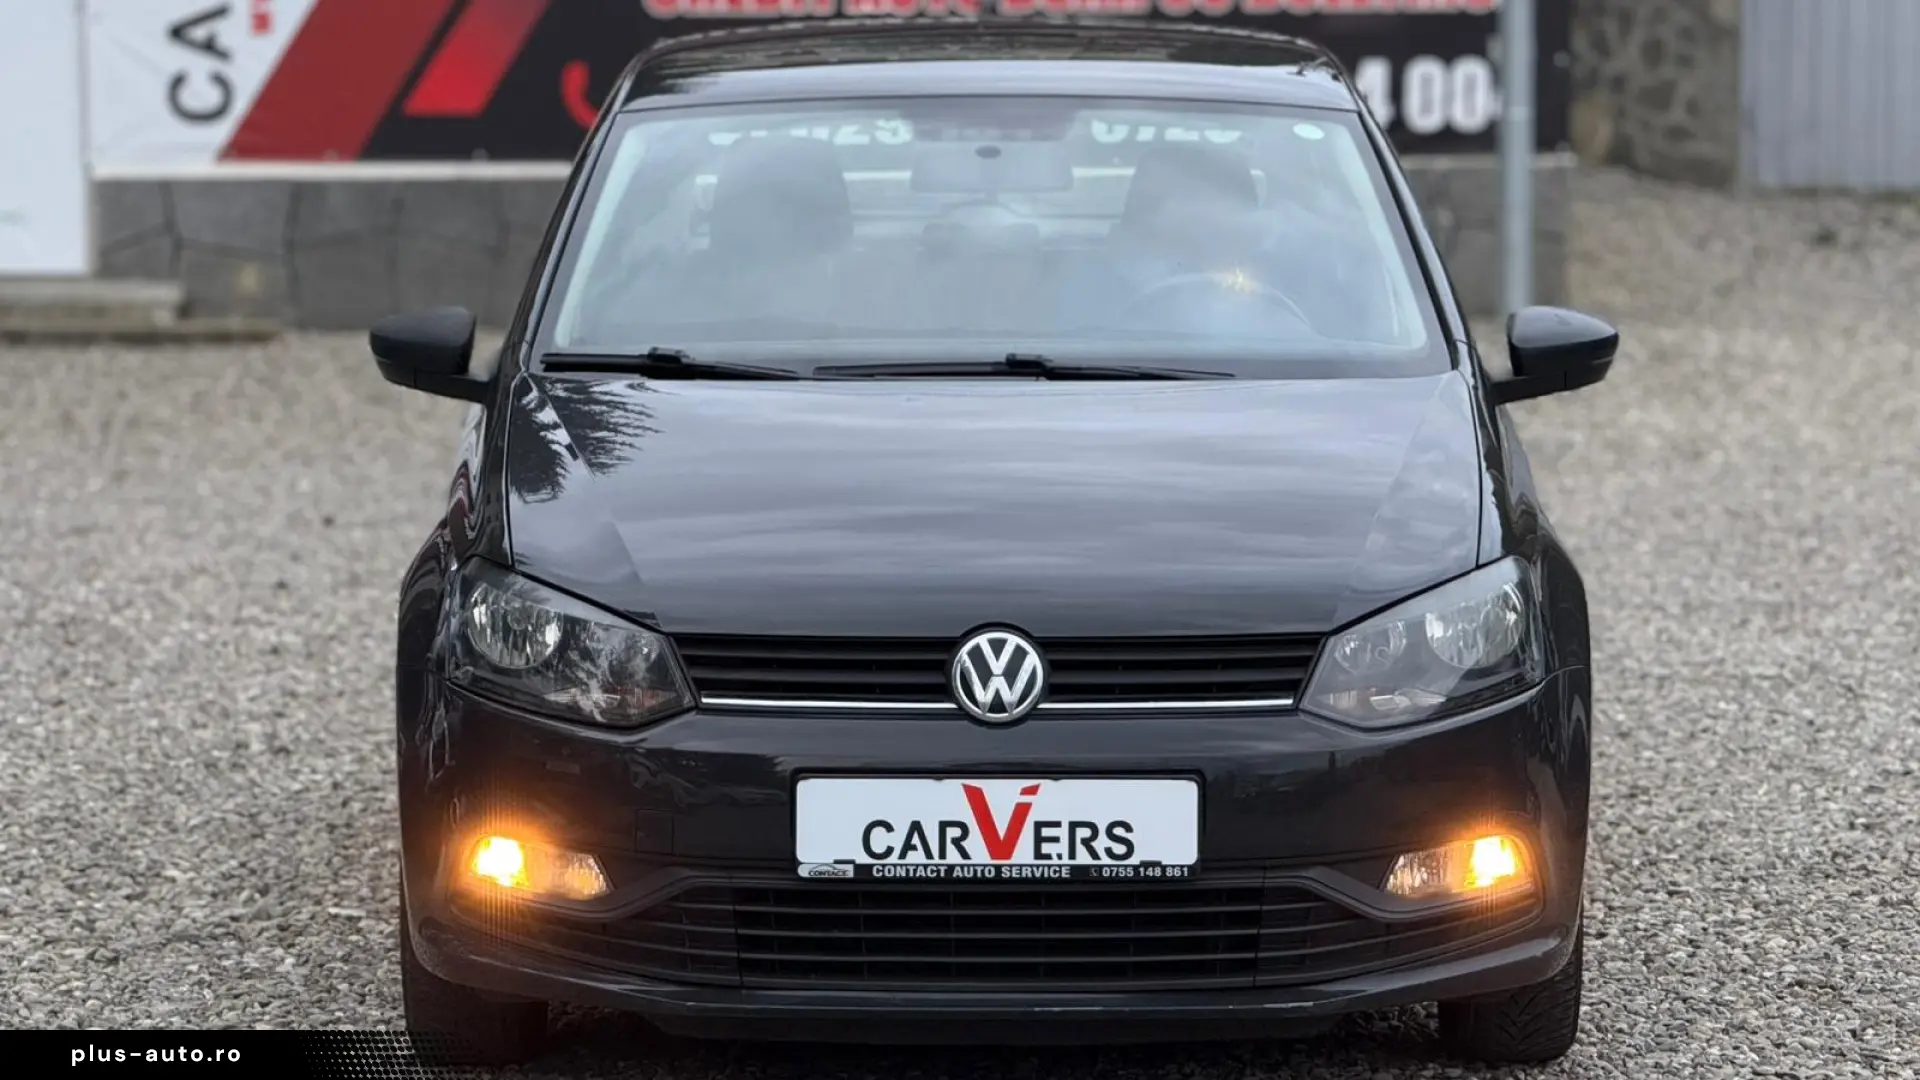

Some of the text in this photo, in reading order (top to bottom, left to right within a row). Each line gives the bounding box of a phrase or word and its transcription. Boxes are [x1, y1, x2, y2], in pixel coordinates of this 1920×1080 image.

[872, 864, 1071, 879] CONTACT AUTO SERVICE
[1102, 866, 1189, 878] 0755 148 861
